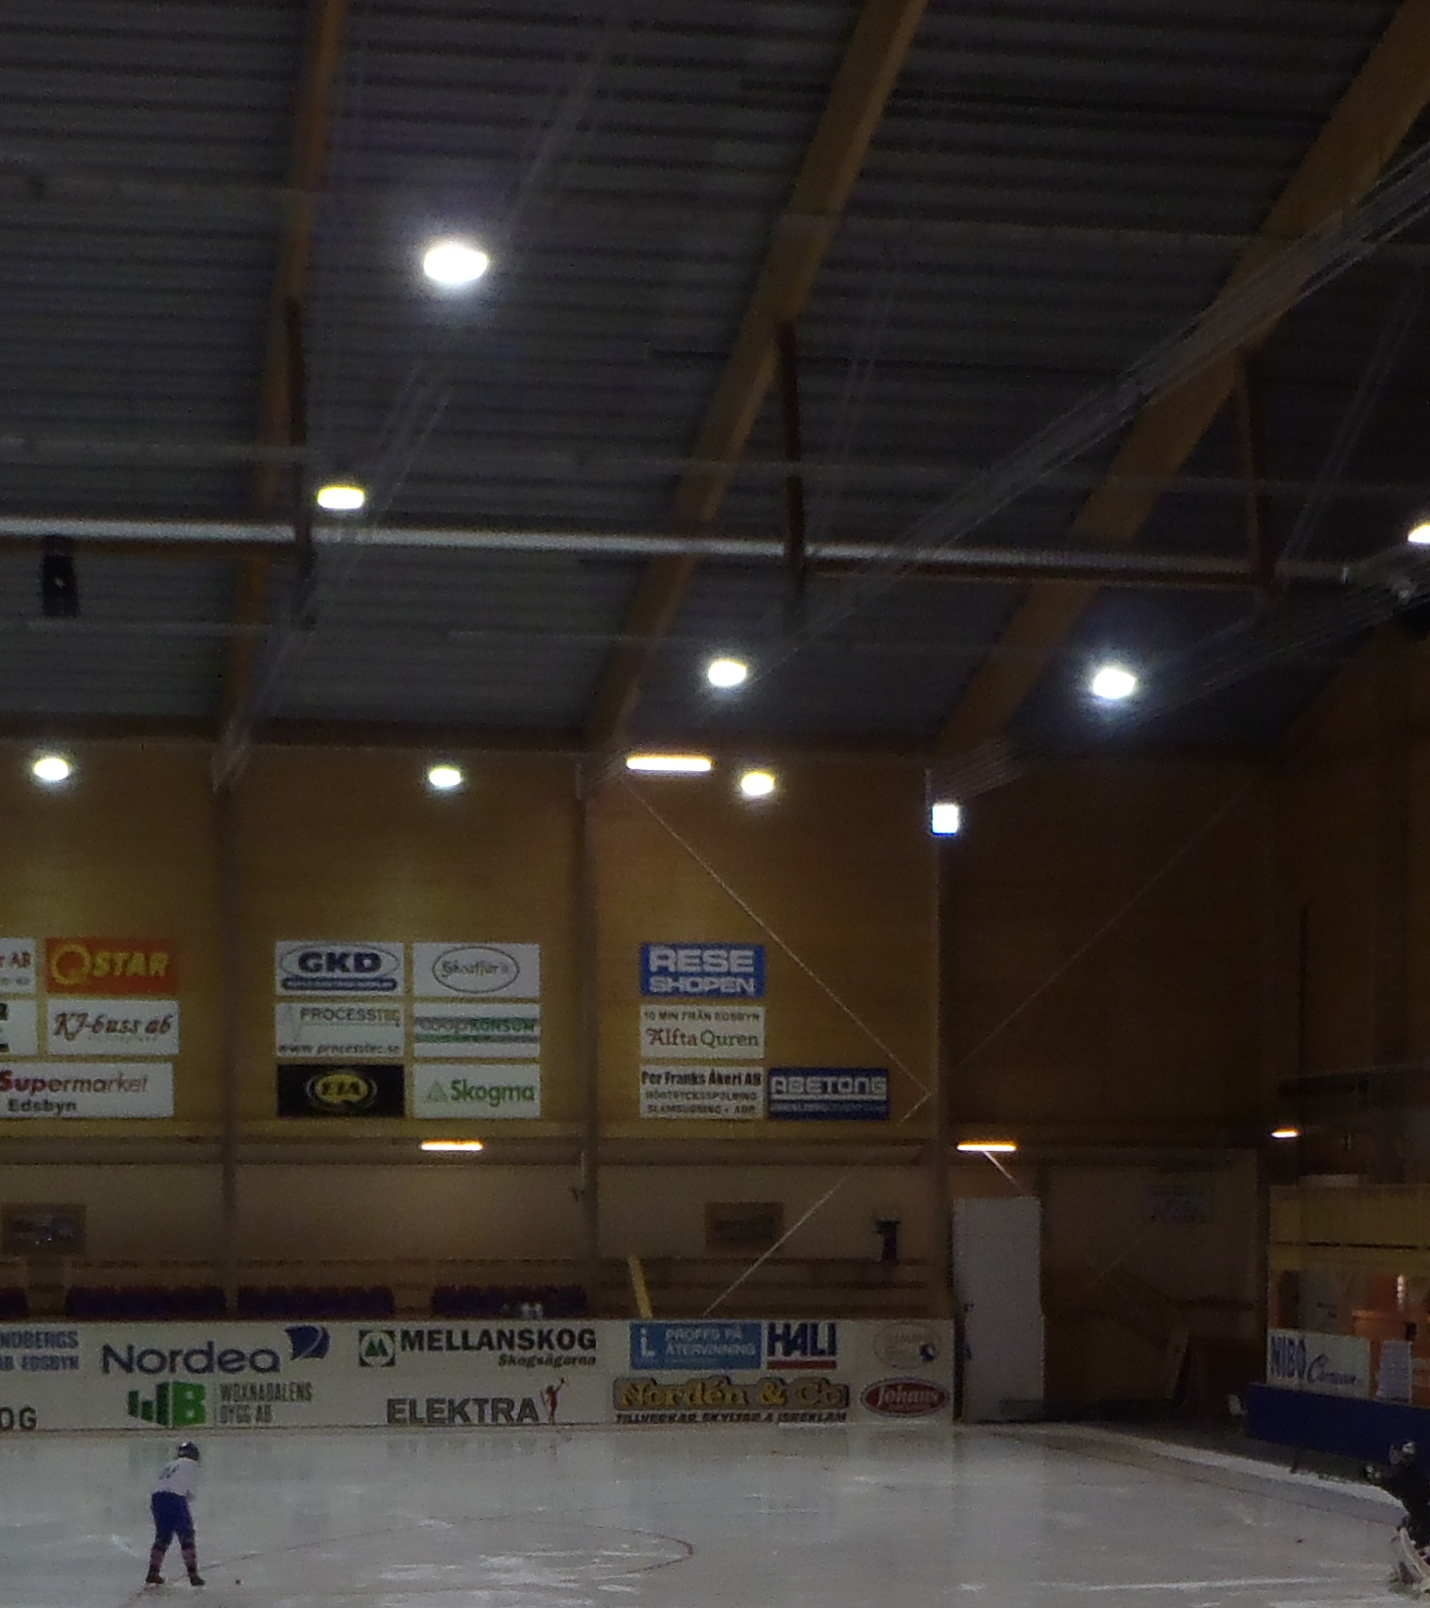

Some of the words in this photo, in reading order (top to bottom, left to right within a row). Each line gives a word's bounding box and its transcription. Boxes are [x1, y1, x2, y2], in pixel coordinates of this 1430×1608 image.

[297, 950, 383, 975] GKD
[648, 947, 755, 973] RESE
[648, 977, 755, 995] SHOPEN
[646, 1027, 698, 1047] Alfta
[450, 1079, 535, 1107] Skogma
[771, 1076, 888, 1095] ABETONG
[7, 1097, 78, 1117] Edsbyn
[399, 1327, 597, 1351] MELLANSKOG
[100, 1340, 281, 1375] Nordea
[621, 1376, 749, 1407] Nordén
[758, 1382, 788, 1406] &
[386, 1397, 540, 1424] ELEKTRA
